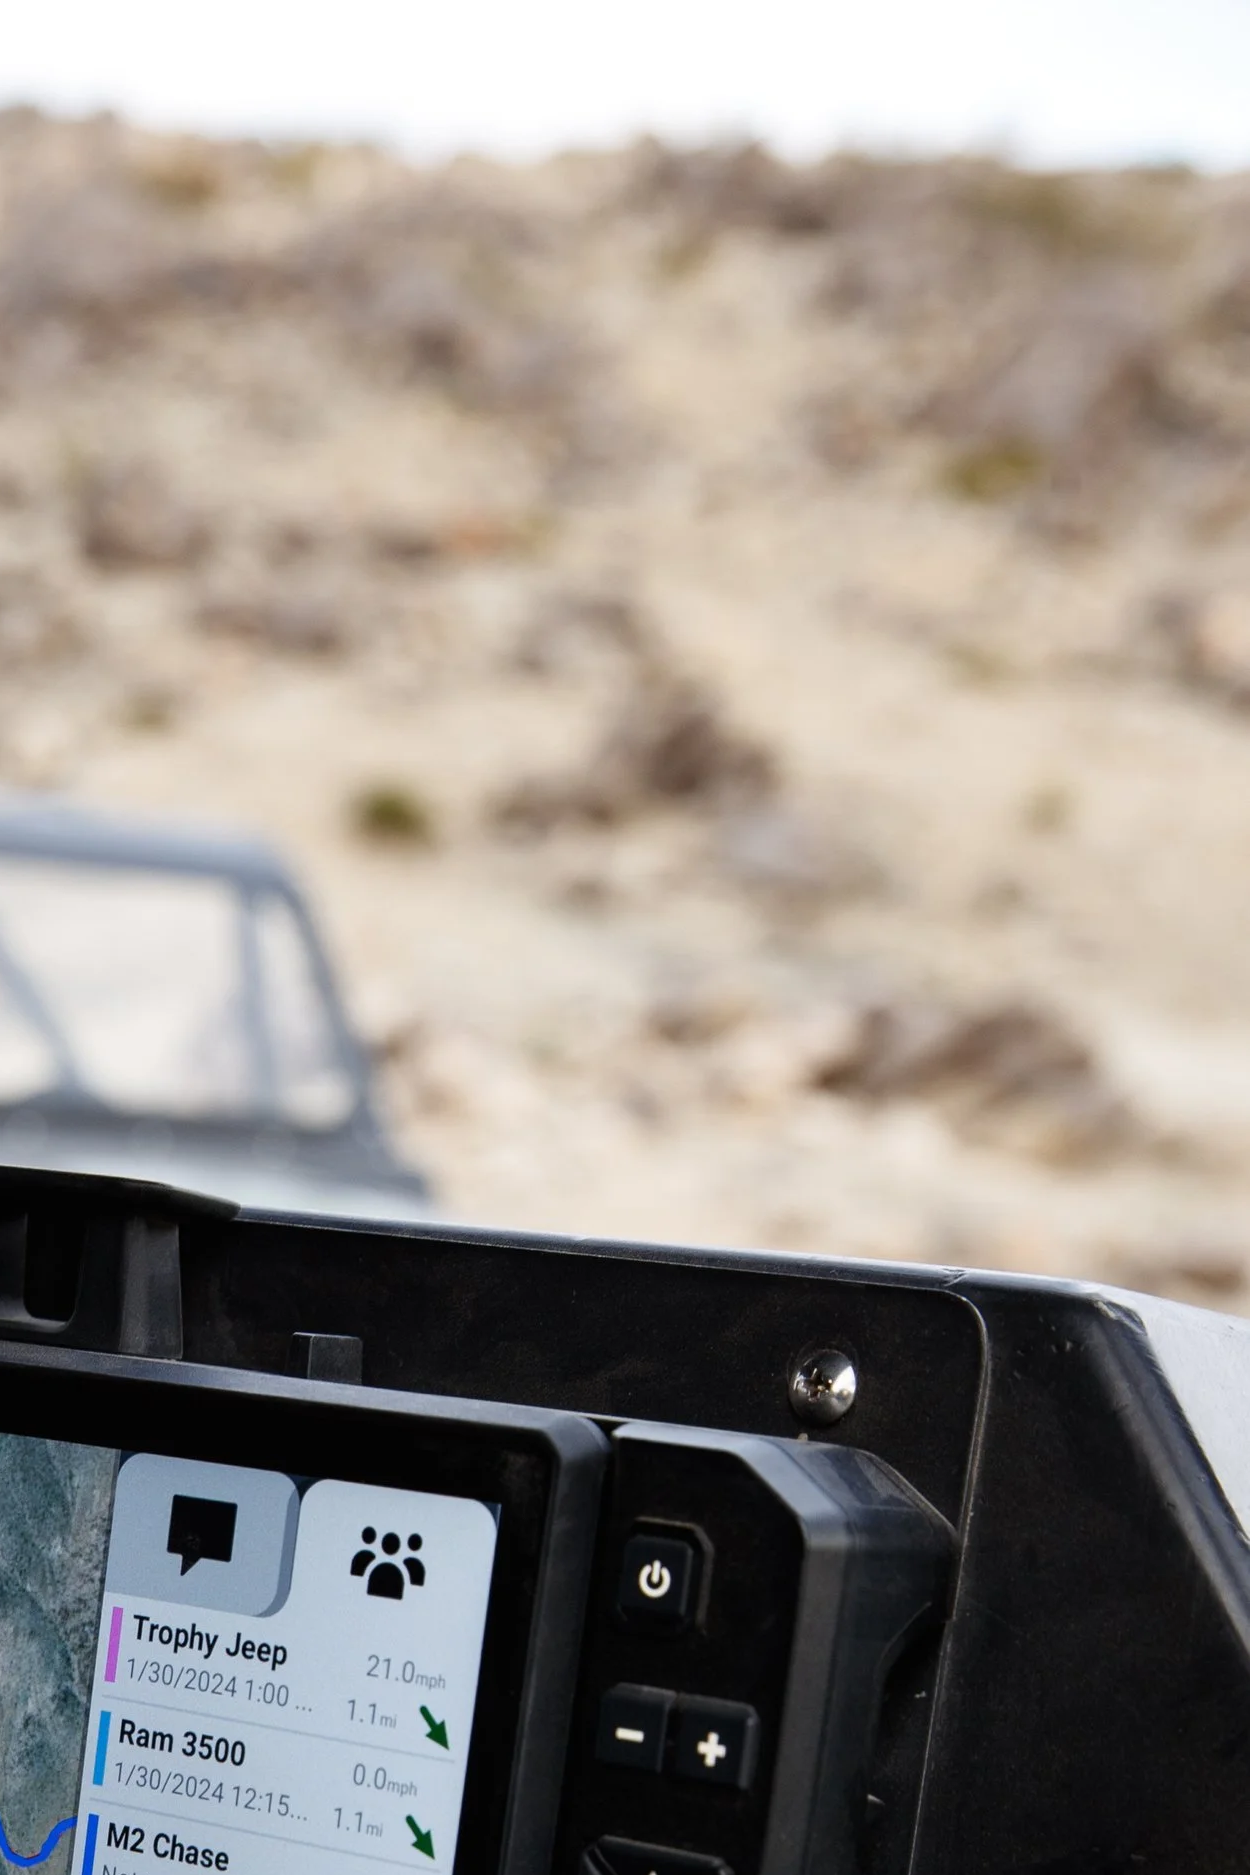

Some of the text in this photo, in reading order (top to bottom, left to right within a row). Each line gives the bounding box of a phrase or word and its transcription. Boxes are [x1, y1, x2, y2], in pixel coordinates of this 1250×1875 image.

[133, 1614, 288, 1671] Trophy Jeep
[127, 1658, 237, 1697] 1/30/2024
[245, 1679, 290, 1707] 1:00
[119, 1718, 246, 1766] Ram 3500
[114, 1762, 225, 1804] 1/30/2024
[106, 1822, 230, 1871] M2 Chase
